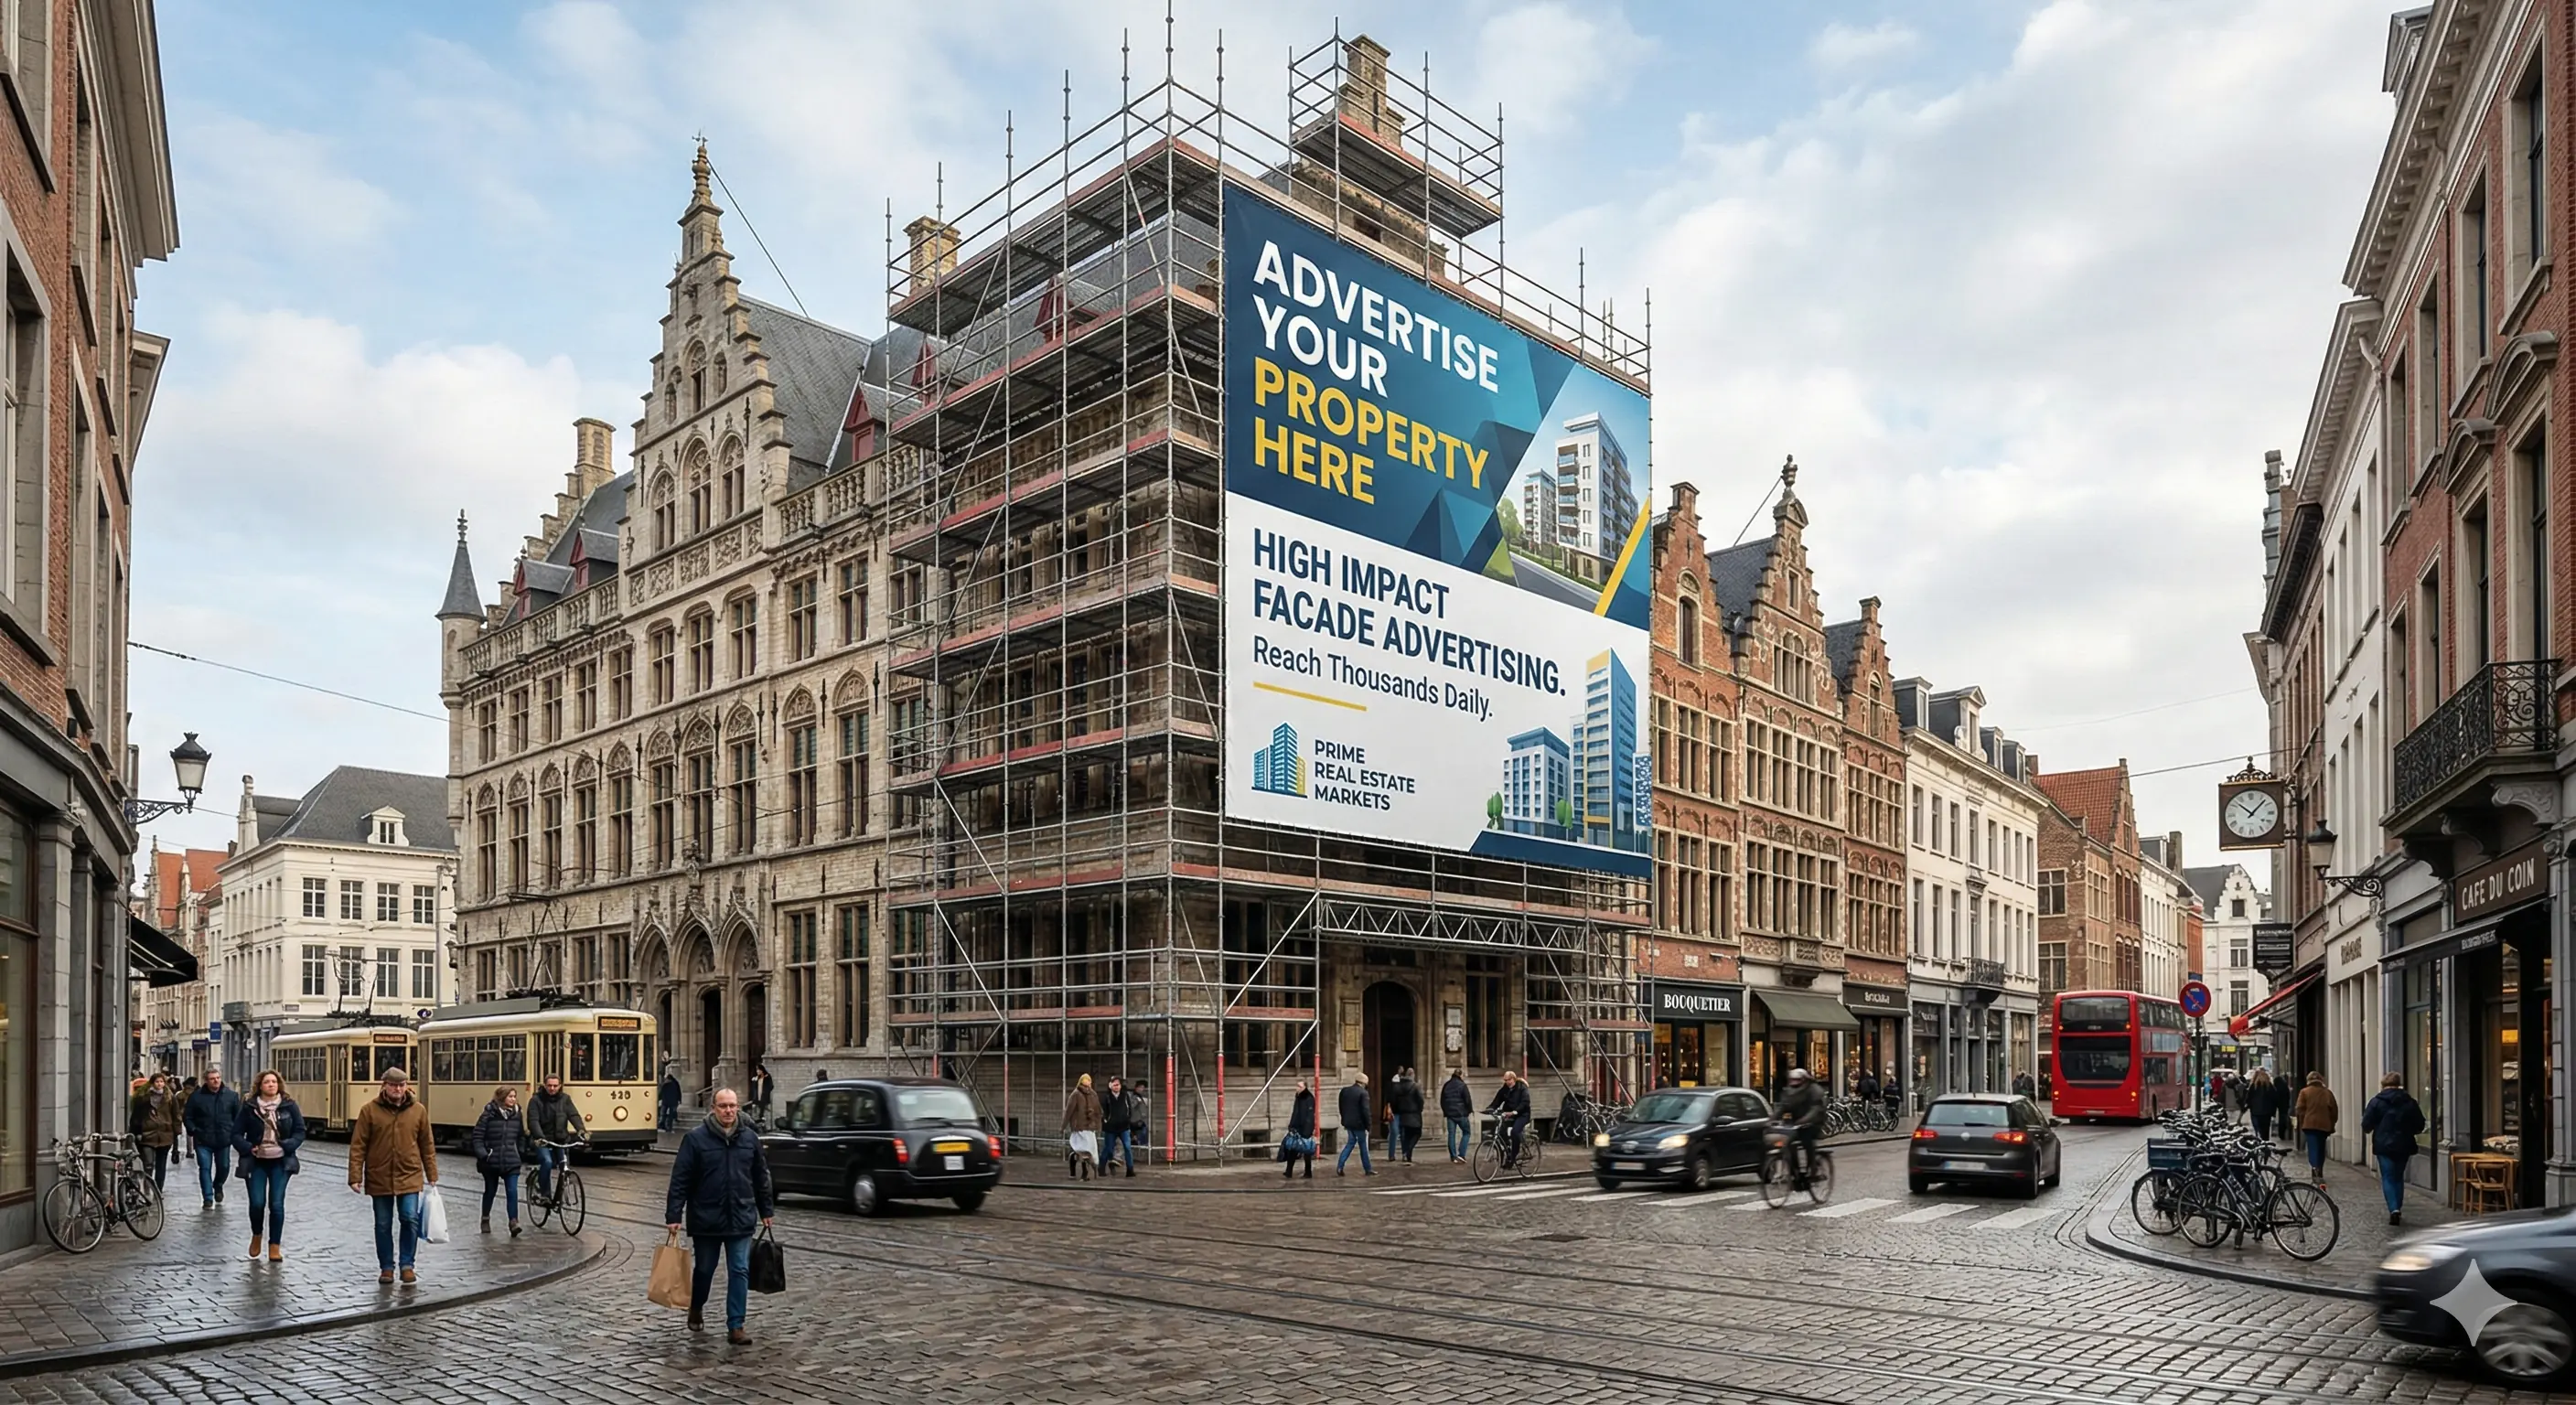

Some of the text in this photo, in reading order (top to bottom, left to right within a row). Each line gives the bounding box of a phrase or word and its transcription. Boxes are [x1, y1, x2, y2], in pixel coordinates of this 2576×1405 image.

[1252, 240, 1498, 393] ADVERTISE
[1252, 294, 1388, 398] YOUR
[1254, 356, 1489, 489] PROPERTY
[1254, 416, 1375, 505] HERE
[1254, 527, 1450, 619] HIGH IMPACT
[1253, 635, 1494, 723] Reach Thousands Daily.
[1254, 578, 1567, 697] FACADE ADVERTISING.
[1315, 739, 1365, 765] PRIME
[1315, 761, 1415, 794] REAL ESTATE
[1315, 784, 1390, 810] MARKETS
[2462, 858, 2535, 910] CAFE DU COIN
